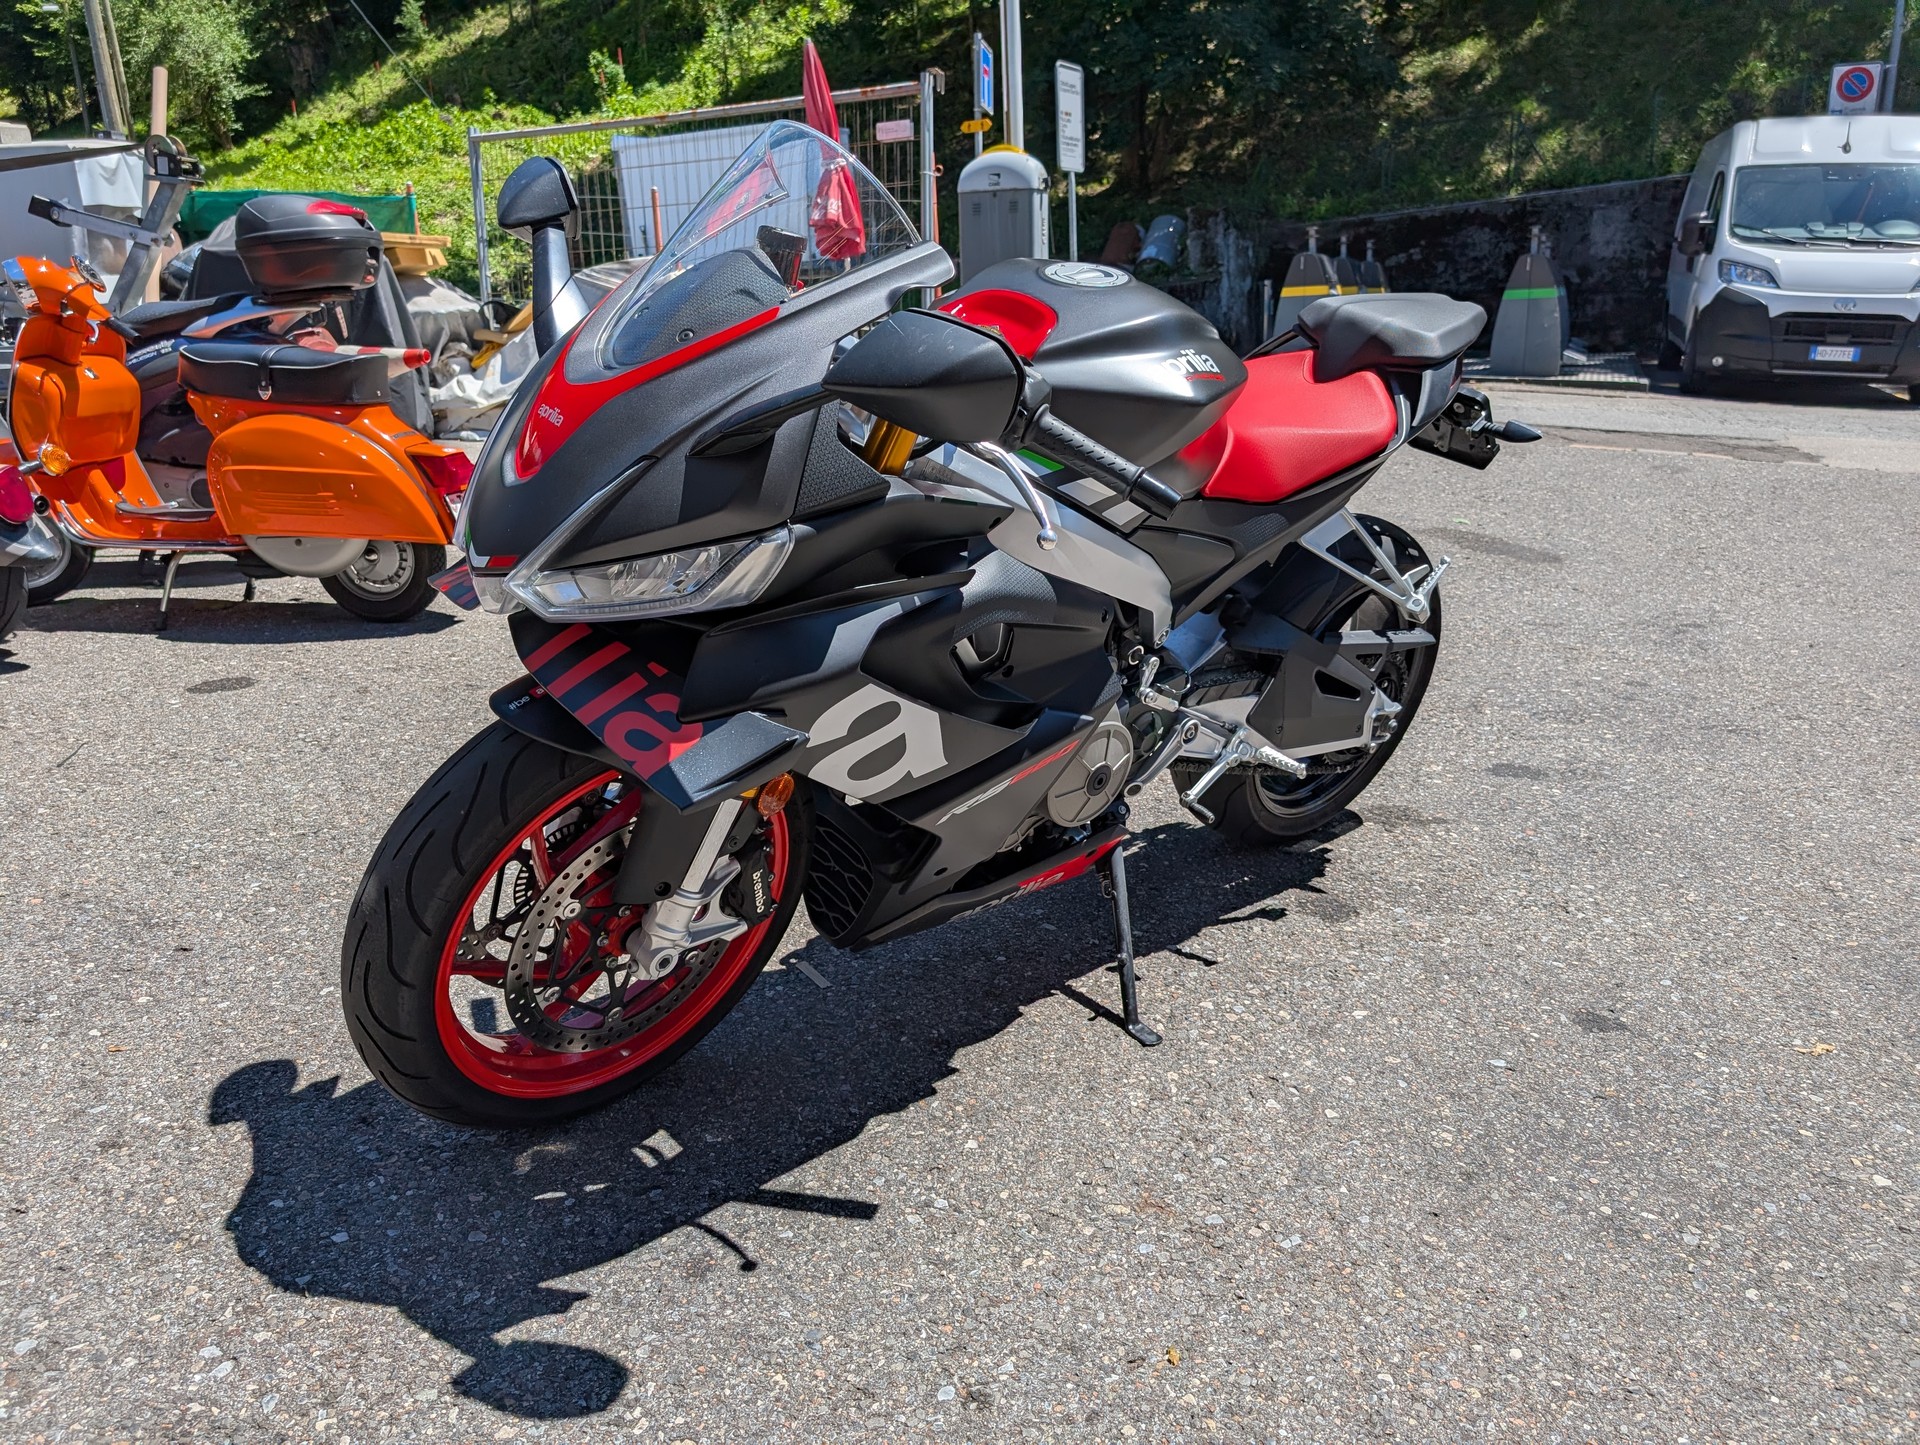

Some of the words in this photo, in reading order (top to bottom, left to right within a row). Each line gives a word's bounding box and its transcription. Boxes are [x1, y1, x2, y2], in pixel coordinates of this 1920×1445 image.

[537, 403, 564, 428] aprilia
[508, 695, 531, 710] #be
[752, 869, 767, 913] brembo
